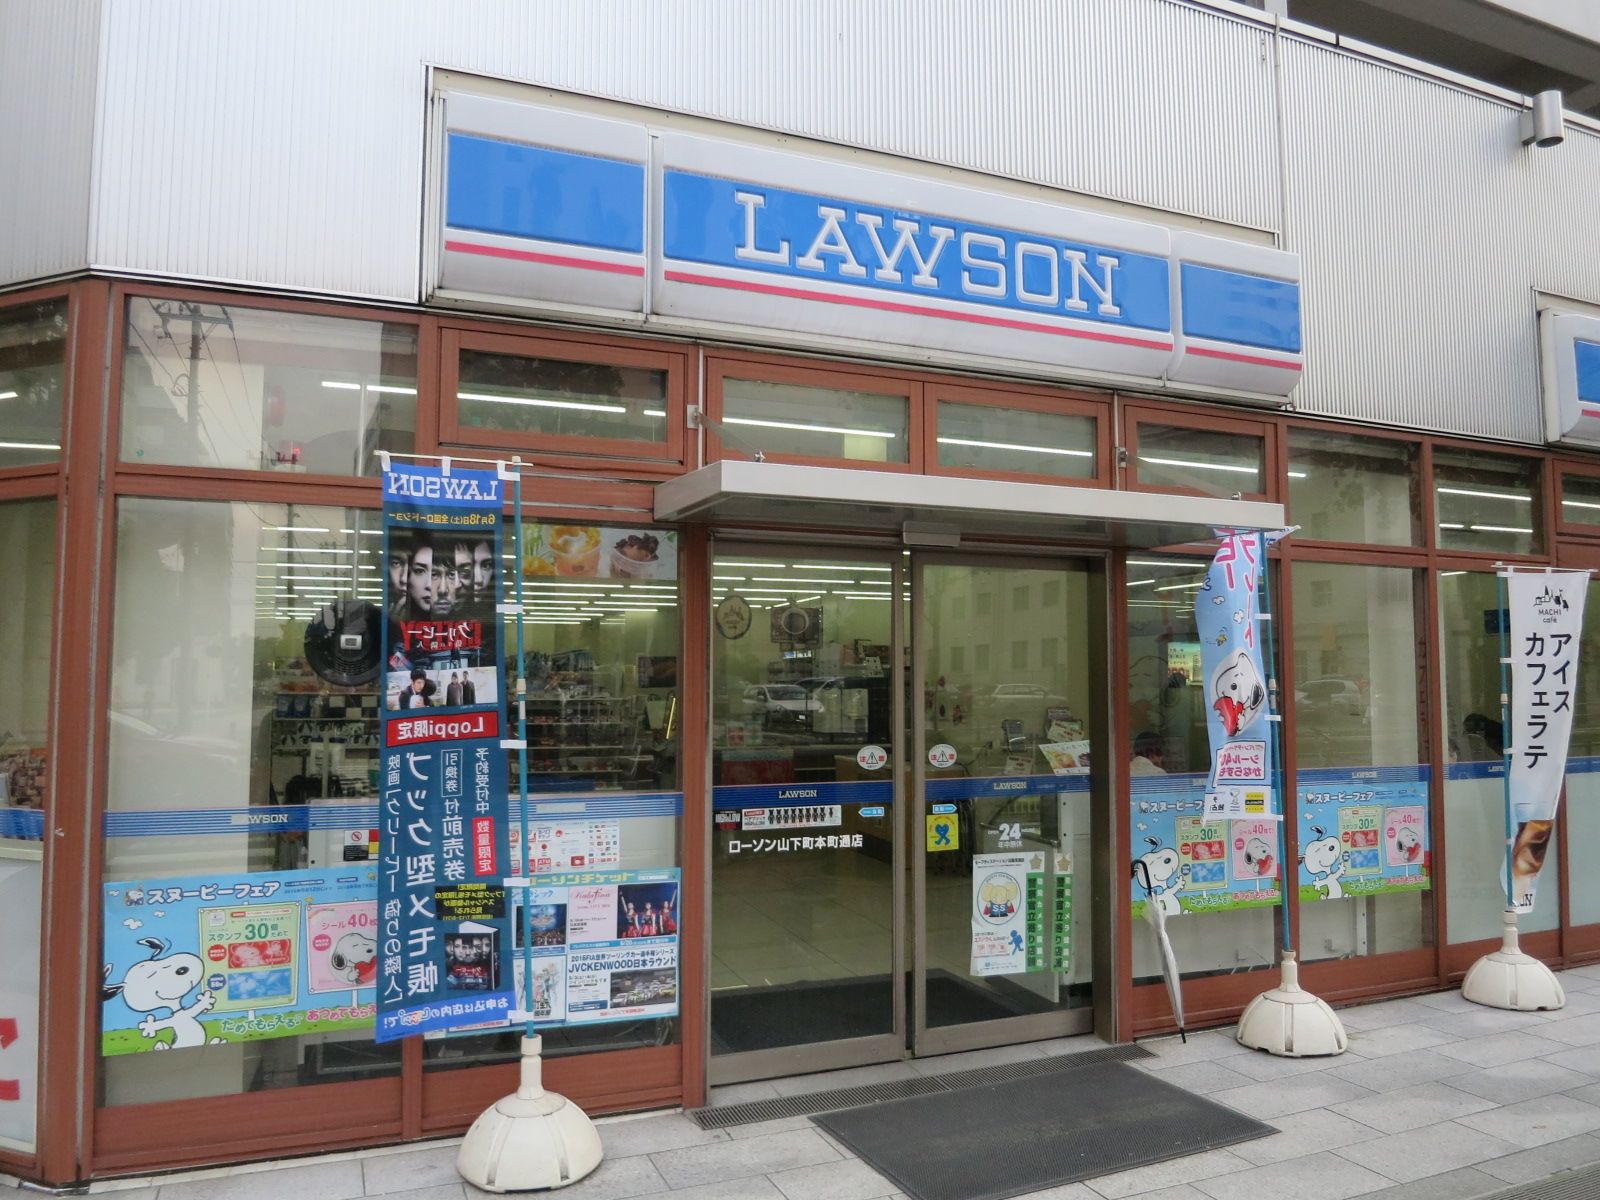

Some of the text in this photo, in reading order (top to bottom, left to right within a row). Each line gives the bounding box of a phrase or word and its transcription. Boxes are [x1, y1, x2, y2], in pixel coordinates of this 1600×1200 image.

[735, 191, 1121, 317] LAWSON
[1550, 633, 1572, 714] アイス
[1523, 632, 1550, 769] カフェラテ
[778, 790, 817, 799] LAWSON
[993, 782, 1027, 790] LAWSON
[1315, 791, 1375, 804] スヌーピーフェア
[999, 823, 1022, 840] 24
[729, 834, 863, 854] ローソン山下町本町通店
[147, 881, 281, 905] スヌーピーフェア
[568, 956, 677, 974] JVCKENWOOD日本ラウンド
